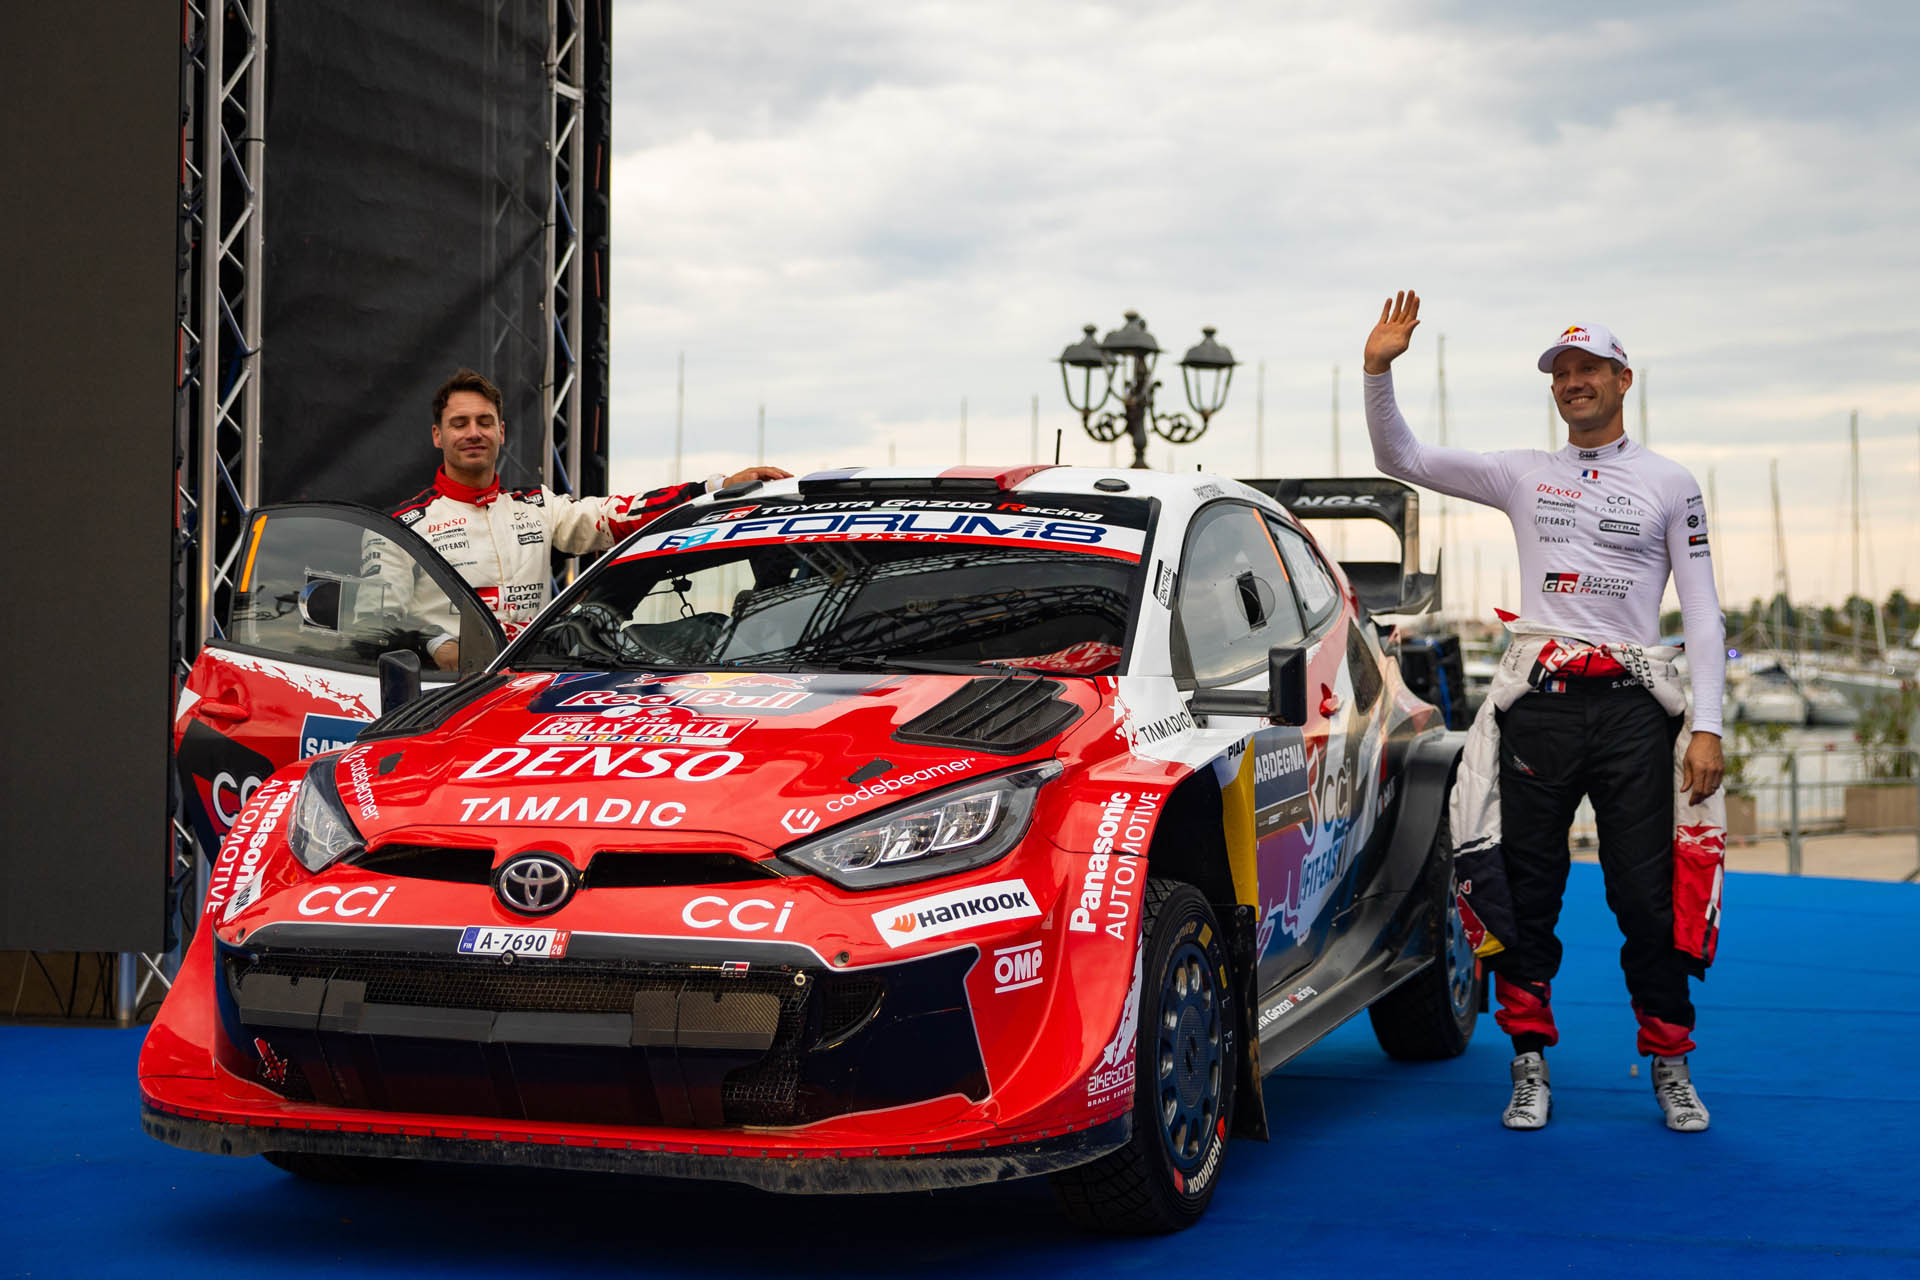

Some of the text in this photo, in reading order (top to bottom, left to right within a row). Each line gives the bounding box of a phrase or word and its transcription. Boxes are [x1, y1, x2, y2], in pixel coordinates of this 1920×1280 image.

[1536, 483, 1582, 499] DENSO
[761, 500, 874, 515] TOYOTA
[879, 499, 992, 511] GAZOO
[997, 503, 1104, 522] Racing
[1537, 497, 1576, 509] Panasonic
[1594, 506, 1645, 517] TAMADIC
[427, 517, 467, 534] DENSO
[723, 513, 1108, 544] FORUM8
[784, 532, 950, 542] フォーラムエイト
[1539, 535, 1570, 543] PRADA
[1159, 566, 1172, 607] CENTRAL
[1543, 579, 1576, 593] GR
[1582, 581, 1629, 592] GAZOO
[1584, 575, 1634, 586] TOYOTA
[1580, 587, 1626, 600] Racing
[557, 690, 814, 709] Red Bull
[622, 716, 672, 724] 2026
[1139, 711, 1192, 744] TAMADIC
[539, 722, 729, 738] RALLY ITALIA
[562, 735, 682, 743] SARDEGNA
[1228, 738, 1246, 760] PIAA
[458, 746, 745, 782] DENSO
[1254, 743, 1305, 785] ARDEGNA
[458, 796, 687, 827] TAMADIC
[206, 779, 284, 914] AUTOMOTIVE
[1069, 791, 1132, 933] Panasonic
[1105, 791, 1162, 941] AUTOMOTIVE
[297, 885, 397, 917] CCi
[682, 895, 795, 933] CCi
[480, 932, 547, 952] A-7690
[556, 932, 567, 942] 11
[994, 949, 1044, 984] OMP
[1267, 998, 1295, 1020] GAZOO
[1287, 984, 1318, 1004] Racing
[1088, 1095, 1110, 1107] BRAKE
